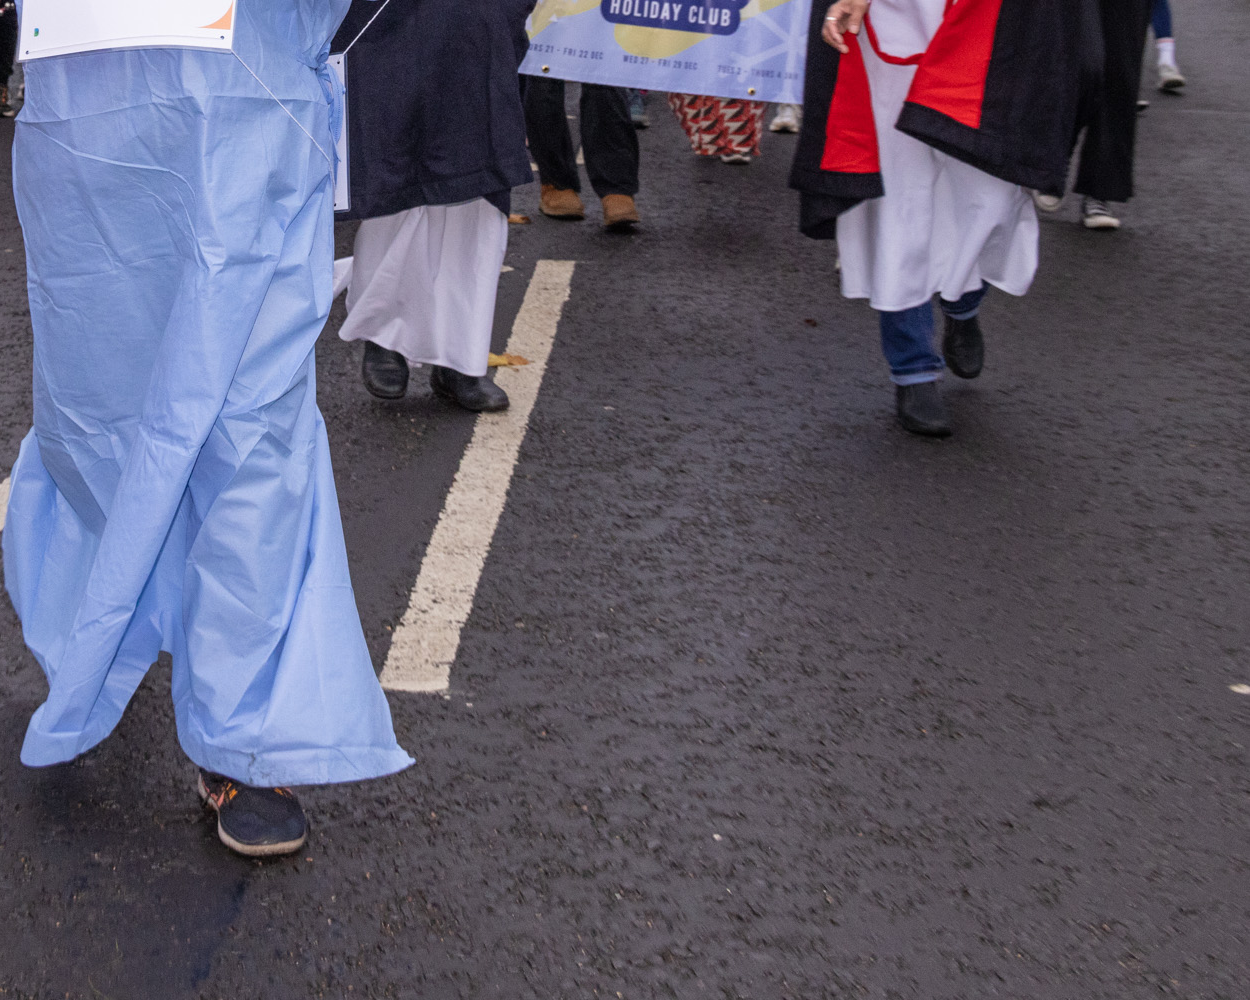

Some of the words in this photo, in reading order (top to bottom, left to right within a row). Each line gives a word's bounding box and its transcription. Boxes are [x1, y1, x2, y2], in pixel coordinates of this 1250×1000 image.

[688, 5, 732, 27] CLUB
[563, 47, 577, 57] FRI
[579, 49, 589, 59] 22
[590, 51, 604, 60] DEC
[623, 55, 637, 64] WED
[685, 61, 698, 71] DEC
